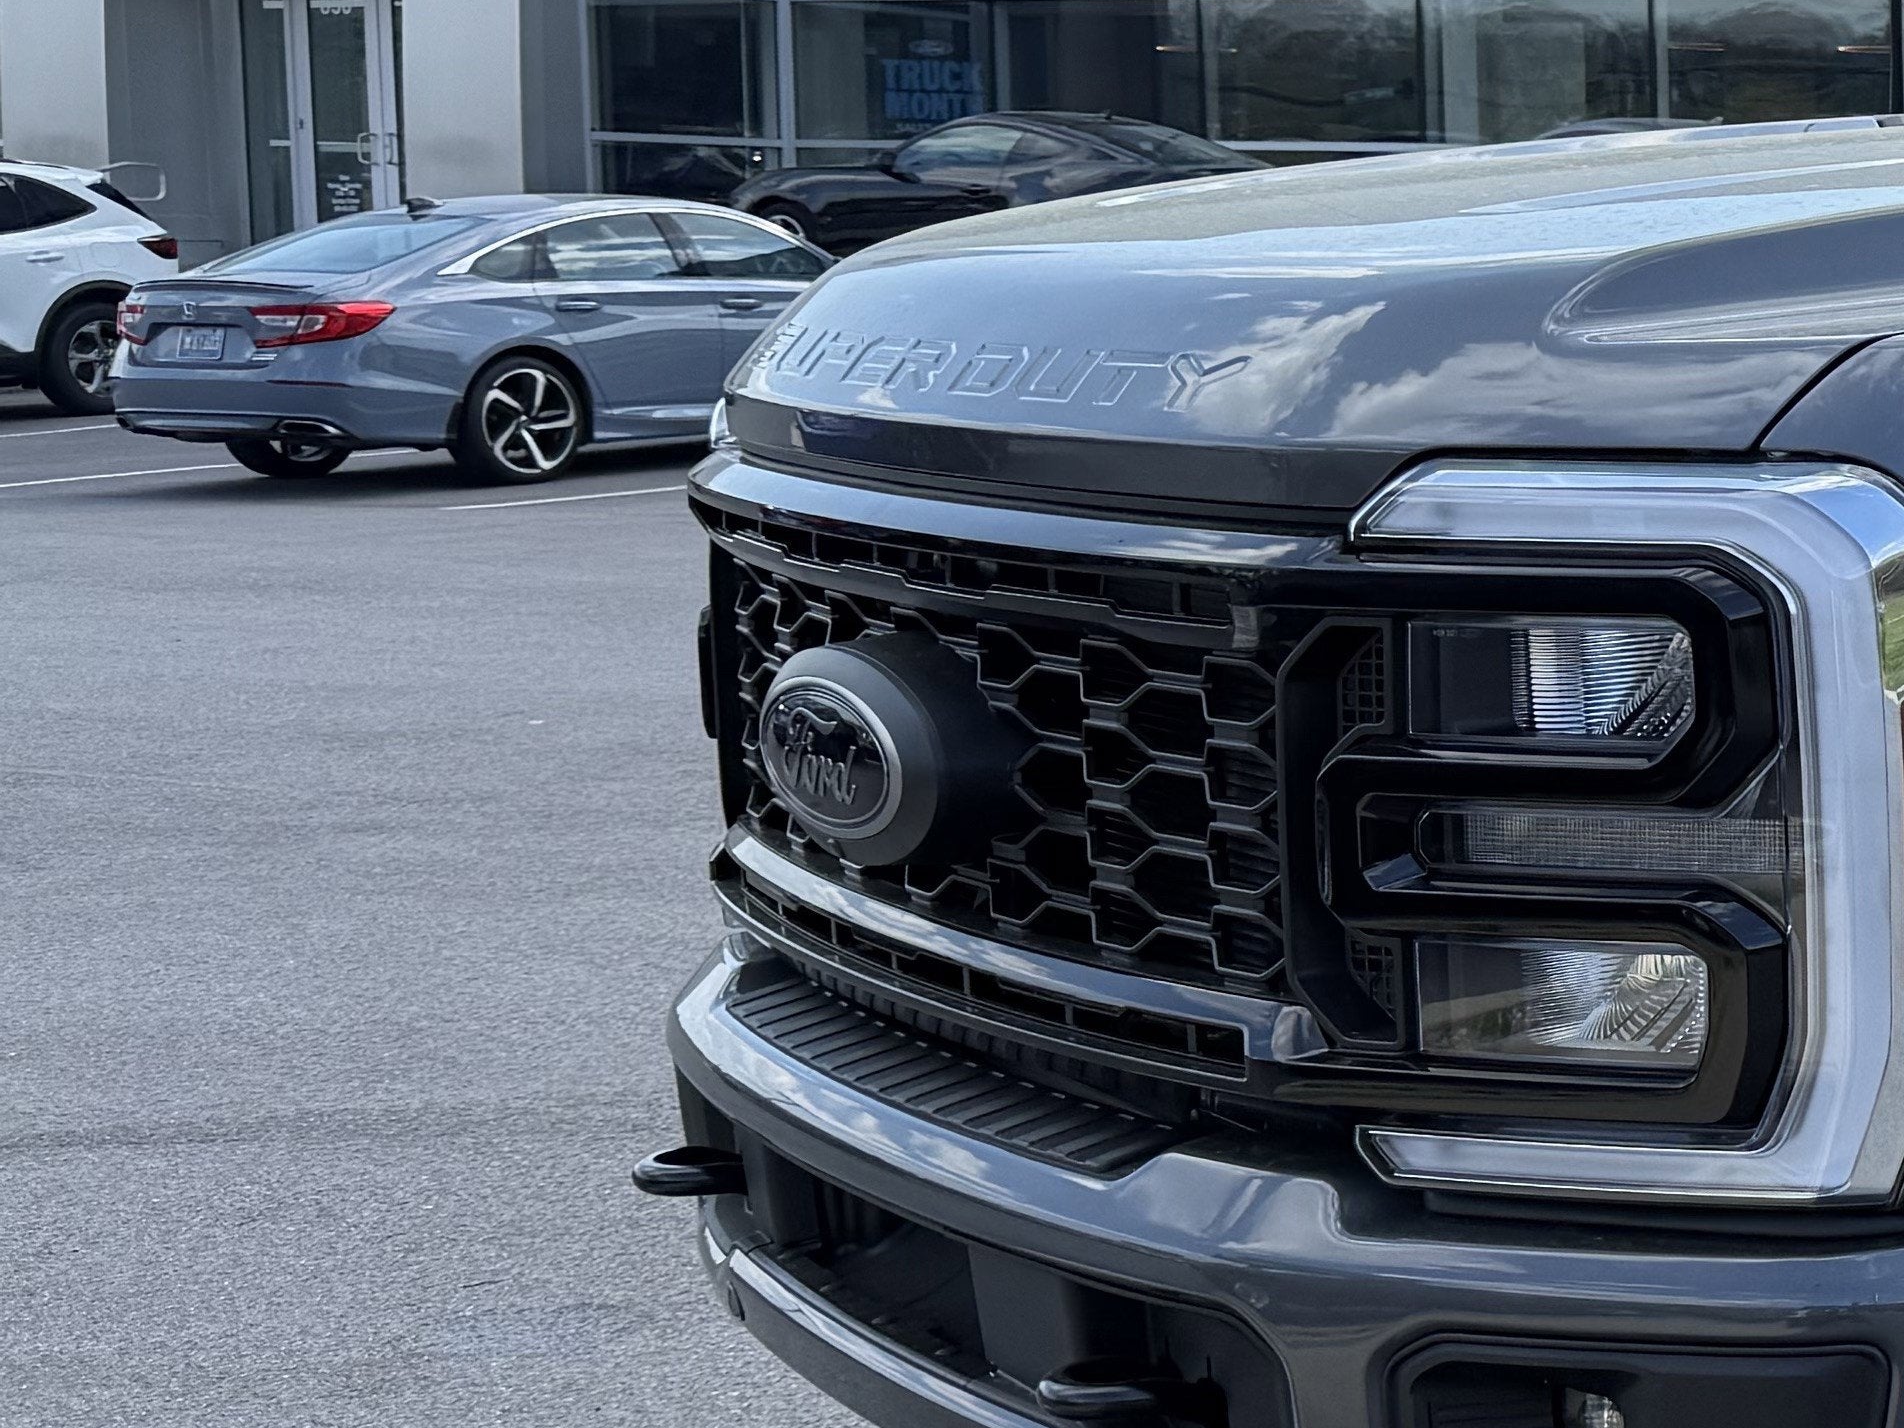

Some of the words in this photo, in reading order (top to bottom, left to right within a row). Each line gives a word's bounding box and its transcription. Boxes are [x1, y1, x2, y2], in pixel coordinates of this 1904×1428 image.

[881, 59, 983, 91] TRUCK
[945, 340, 1254, 414] DUTY
[783, 706, 858, 805] Ford
